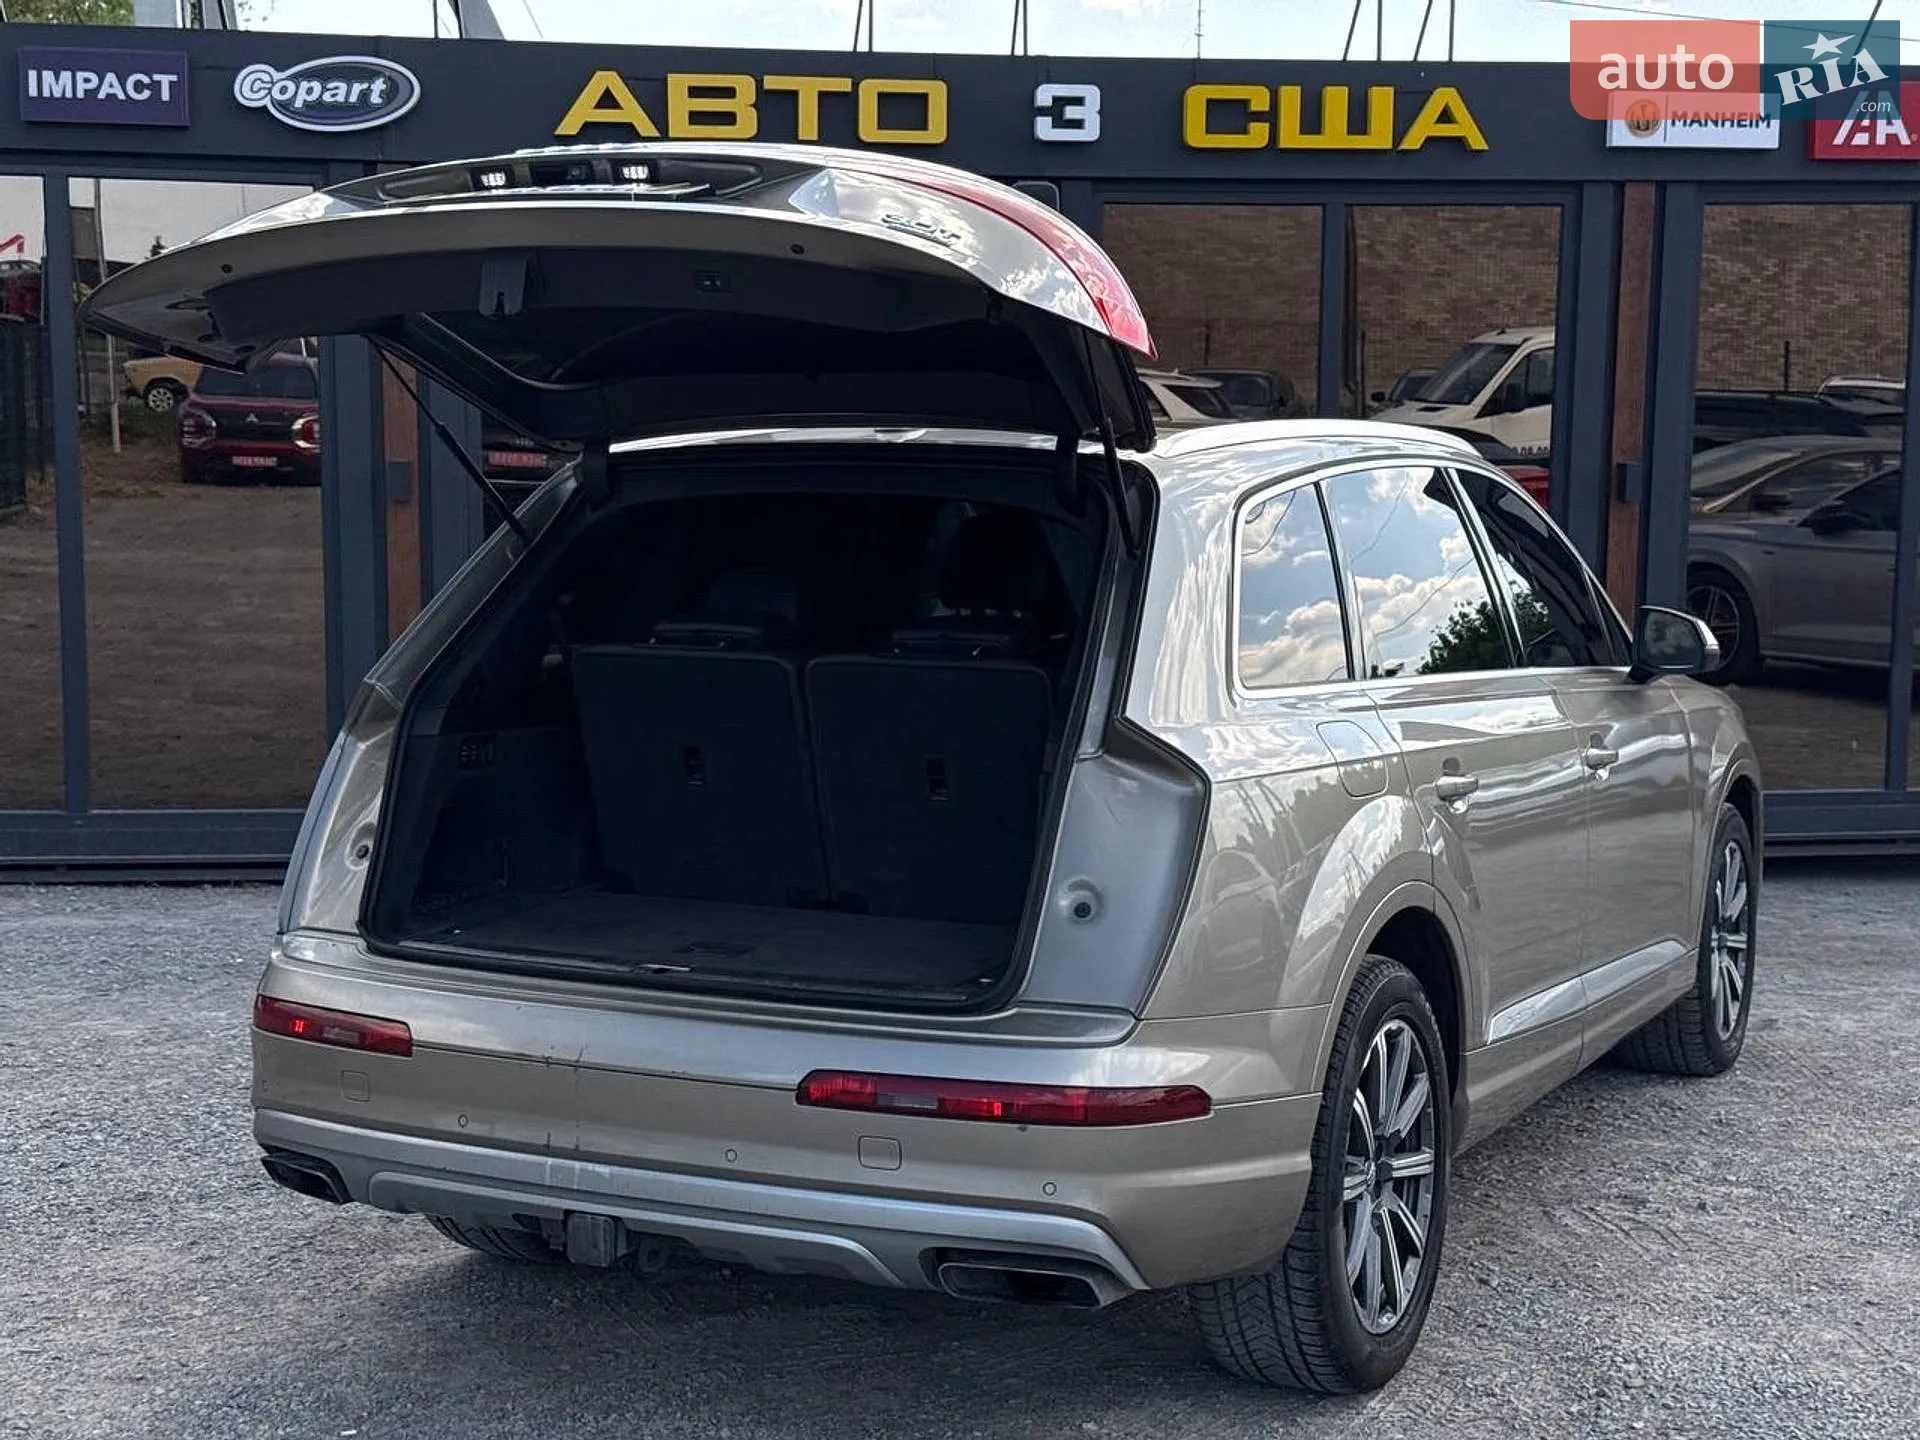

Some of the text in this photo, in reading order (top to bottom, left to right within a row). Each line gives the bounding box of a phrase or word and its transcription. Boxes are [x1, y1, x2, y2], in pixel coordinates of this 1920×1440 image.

[27, 69, 178, 102] IMPACT
[241, 70, 387, 108] Copart
[554, 71, 948, 144] АВТО
[1184, 85, 1489, 151] США
[1671, 111, 1771, 129] MANHEIM
